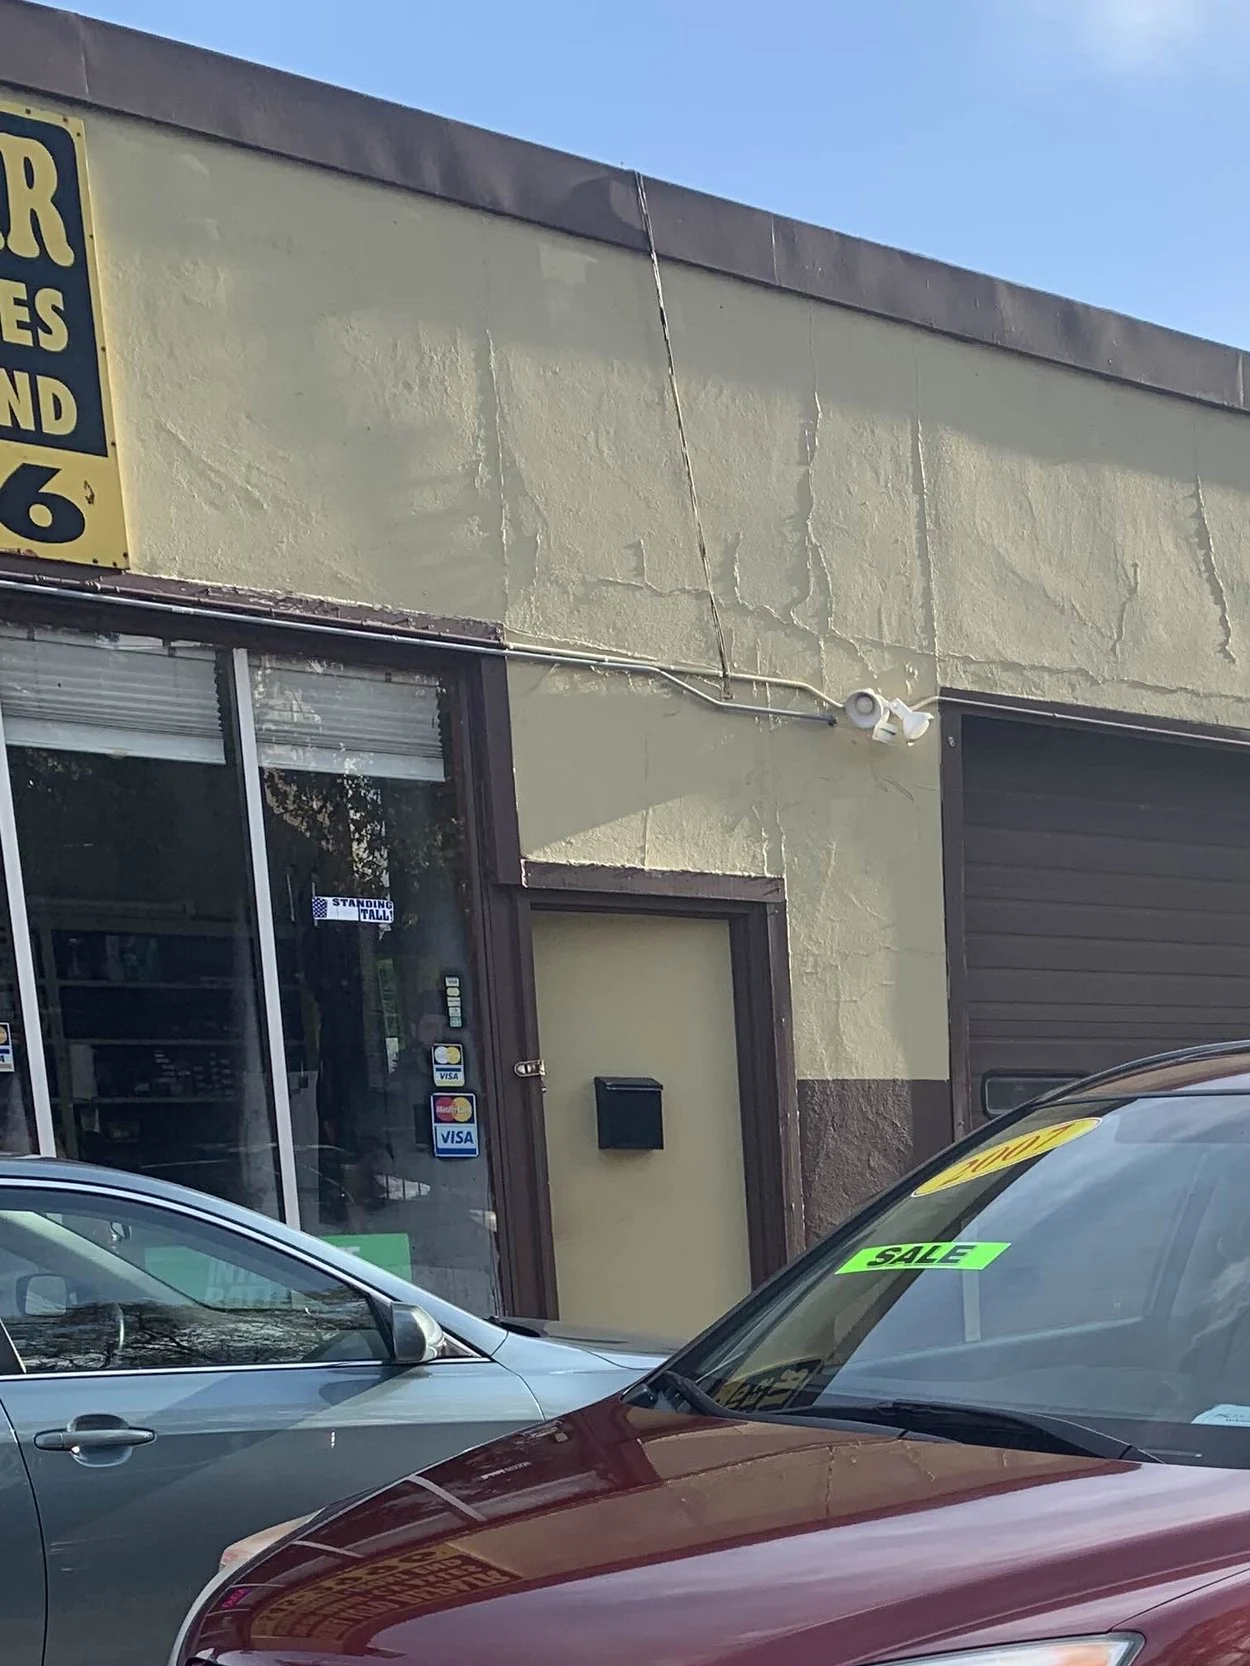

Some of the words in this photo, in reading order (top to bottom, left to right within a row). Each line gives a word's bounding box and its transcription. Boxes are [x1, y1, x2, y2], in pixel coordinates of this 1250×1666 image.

[0, 132, 75, 267] R
[0, 278, 69, 352] ES
[332, 898, 393, 909] STANDING
[361, 908, 393, 921] TALL!
[440, 1072, 459, 1080] VISA
[441, 1130, 474, 1144] VISA
[938, 1123, 1077, 1188] 2007
[866, 1245, 977, 1267] SALE
